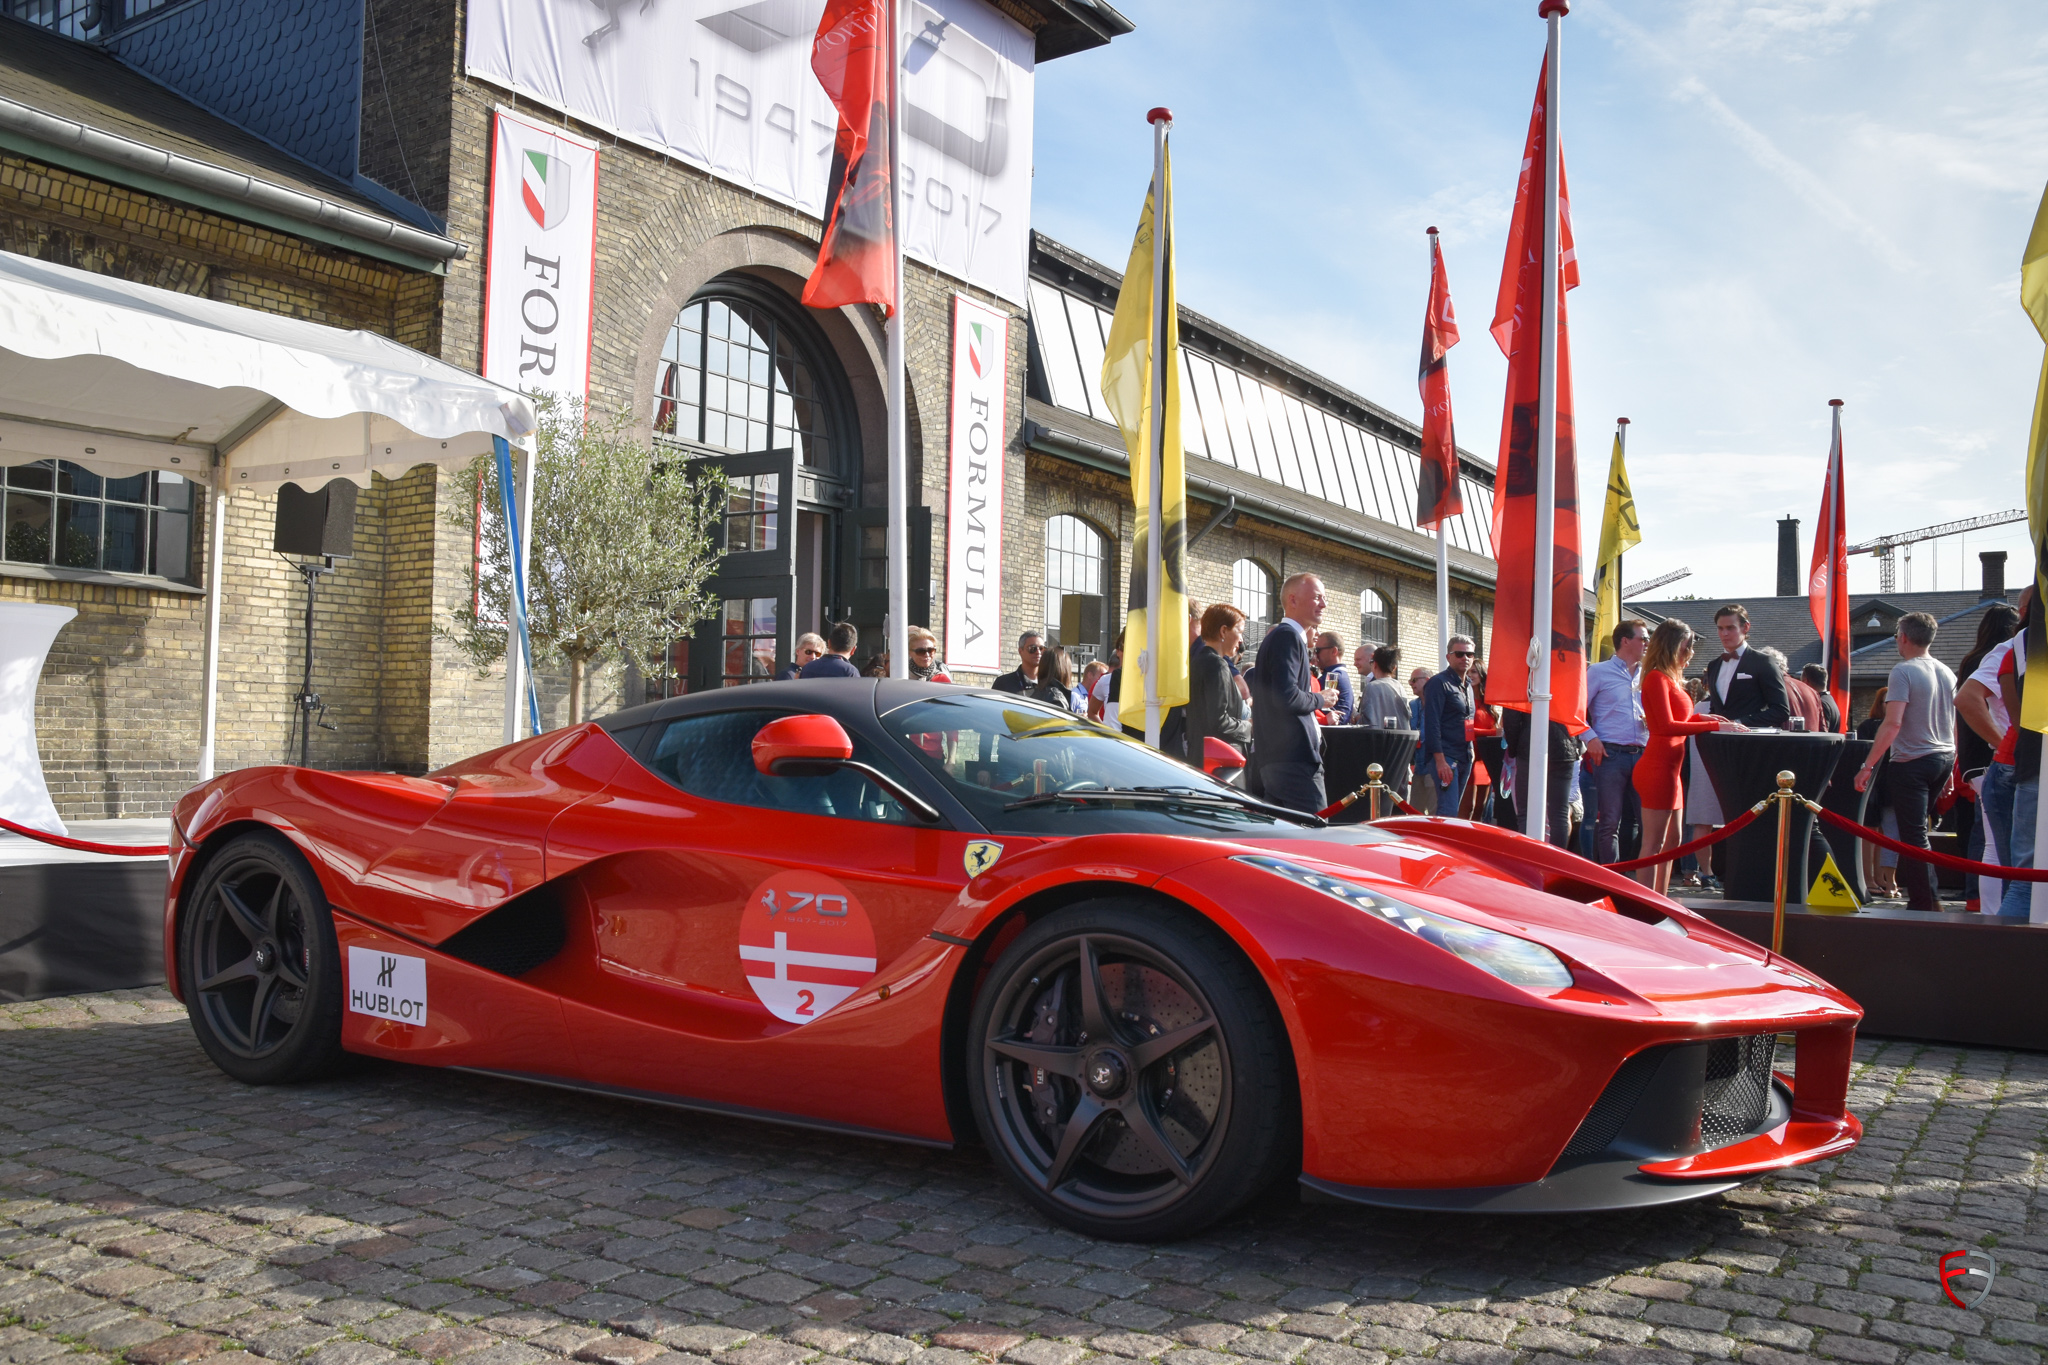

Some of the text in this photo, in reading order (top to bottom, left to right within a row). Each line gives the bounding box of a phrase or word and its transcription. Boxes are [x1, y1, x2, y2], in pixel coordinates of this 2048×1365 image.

[518, 245, 561, 397] FOR
[963, 390, 990, 650] FORMULA
[786, 891, 848, 917] 70
[352, 989, 424, 1020] HUBLOT
[796, 989, 815, 1016] 2
